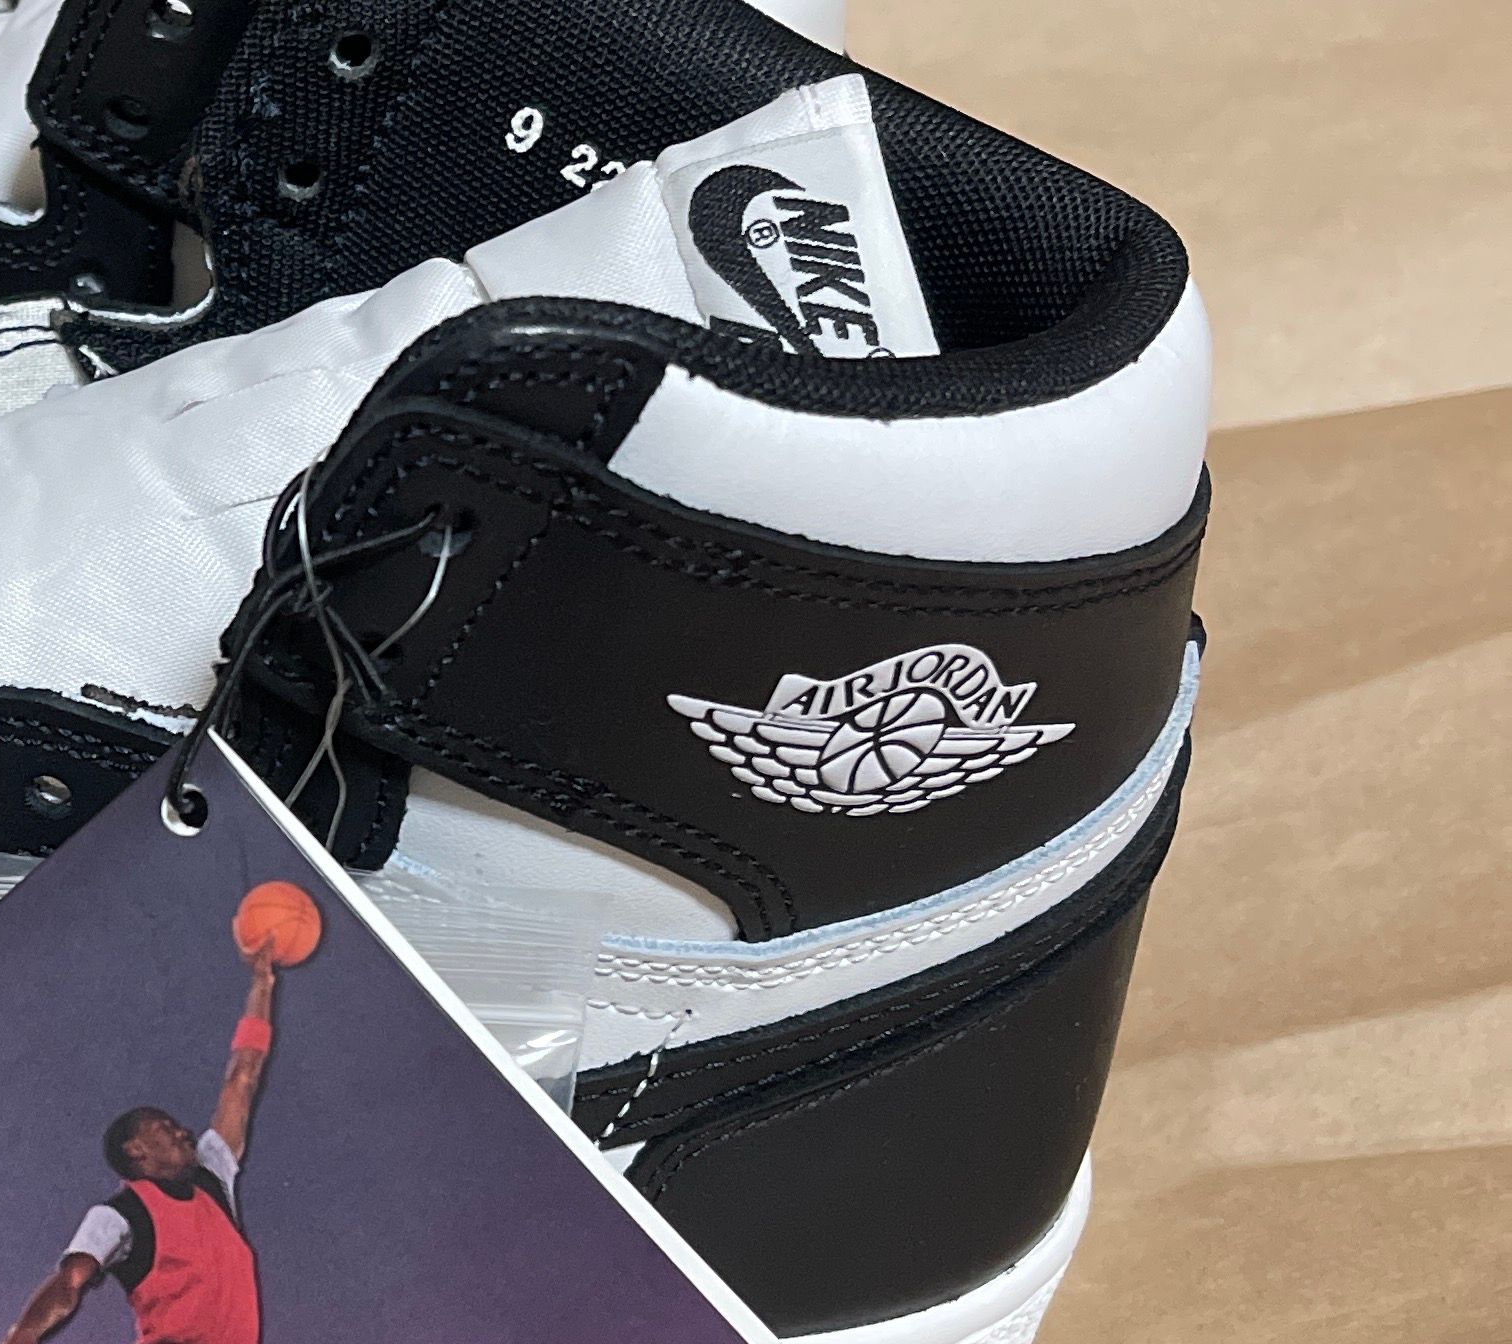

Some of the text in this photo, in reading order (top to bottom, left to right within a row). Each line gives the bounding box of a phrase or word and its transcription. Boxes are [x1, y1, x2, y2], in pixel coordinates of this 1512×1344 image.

[505, 107, 543, 153] 9
[773, 196, 880, 346] NIKE
[781, 651, 1028, 724] AIR JORDAN
